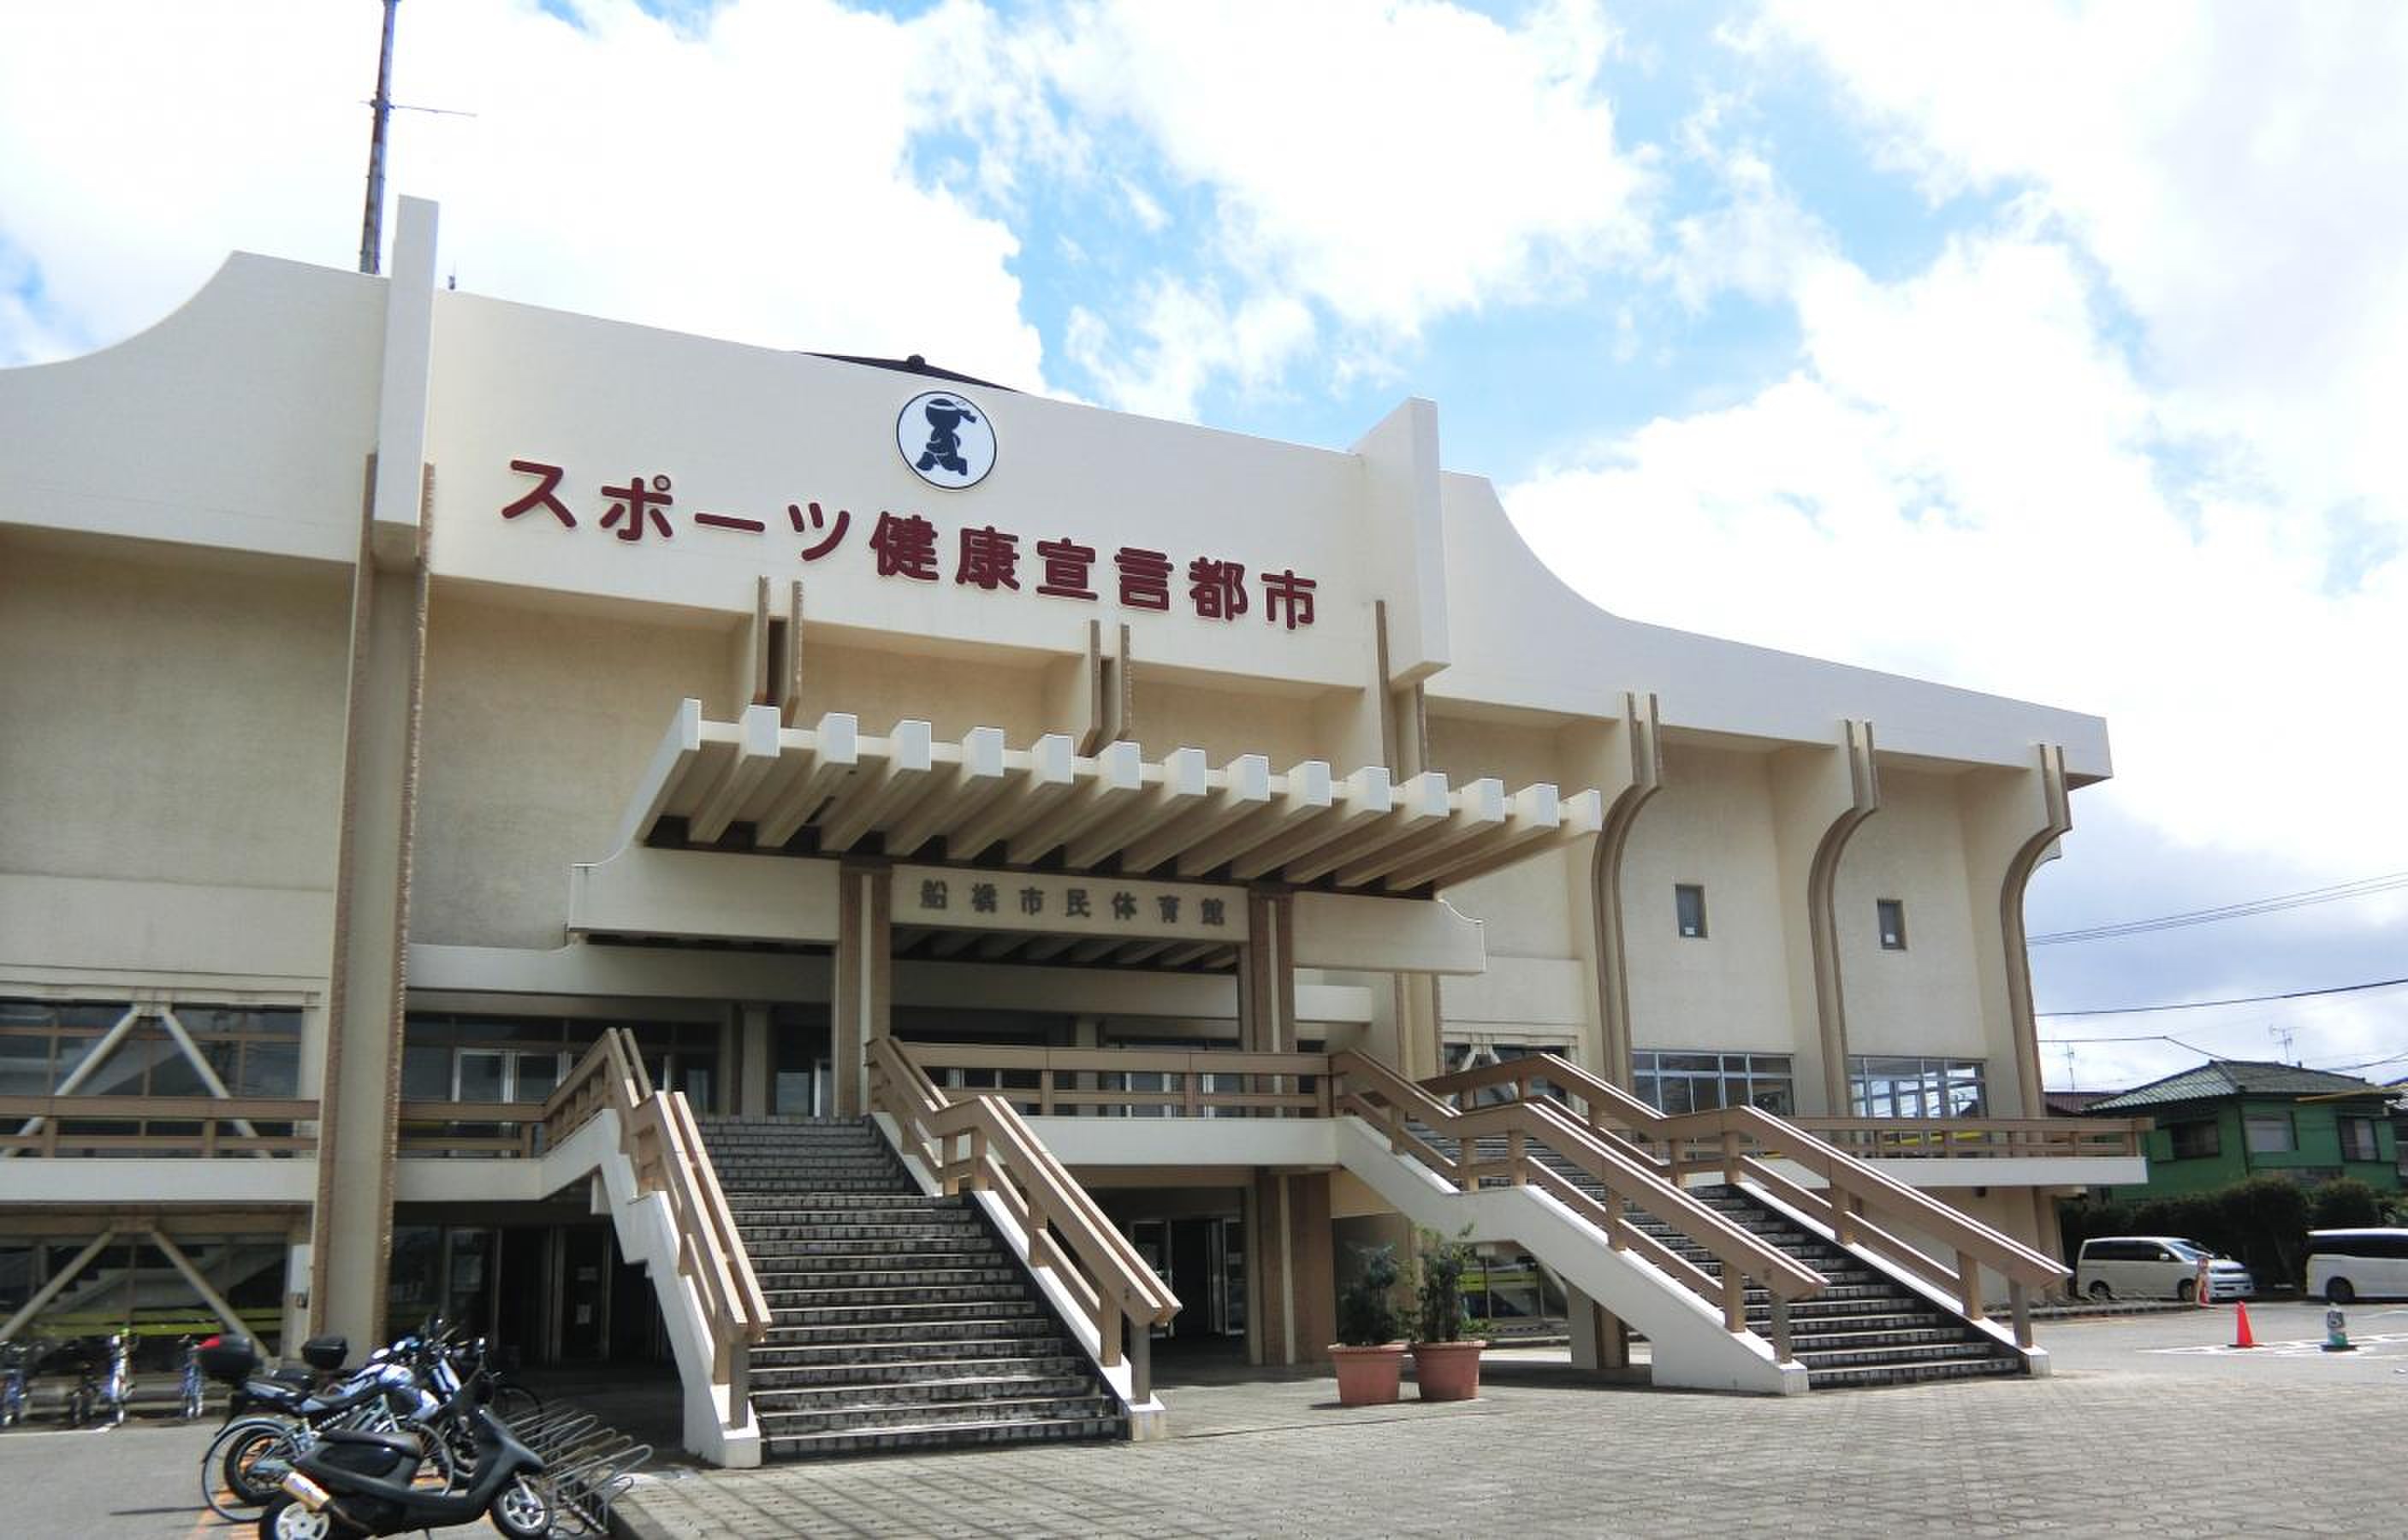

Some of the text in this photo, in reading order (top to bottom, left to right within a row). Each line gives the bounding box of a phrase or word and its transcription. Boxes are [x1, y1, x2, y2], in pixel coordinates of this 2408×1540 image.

[501, 459, 1316, 628] スポーツ健康宣言都市
[920, 880, 1225, 926] 船橋市民体育館
